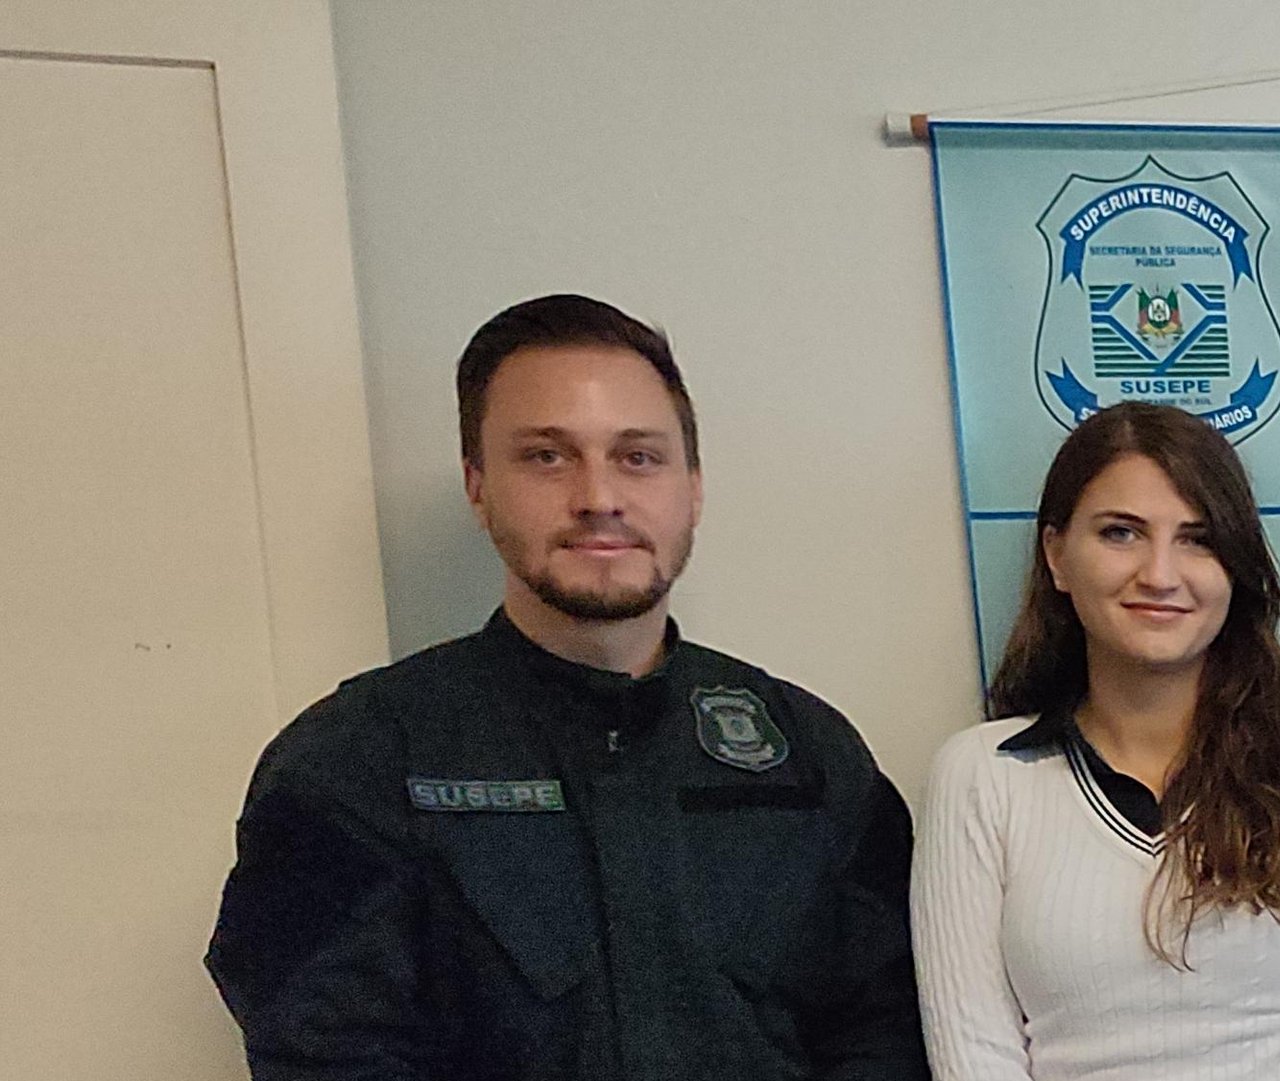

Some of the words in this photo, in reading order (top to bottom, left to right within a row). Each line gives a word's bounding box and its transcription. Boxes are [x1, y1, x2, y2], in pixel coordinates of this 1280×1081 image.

[1070, 187, 1236, 243] SUPERINTENDÊNCIA
[1120, 380, 1211, 393] SUSEPE
[414, 783, 558, 807] SUSEPE
